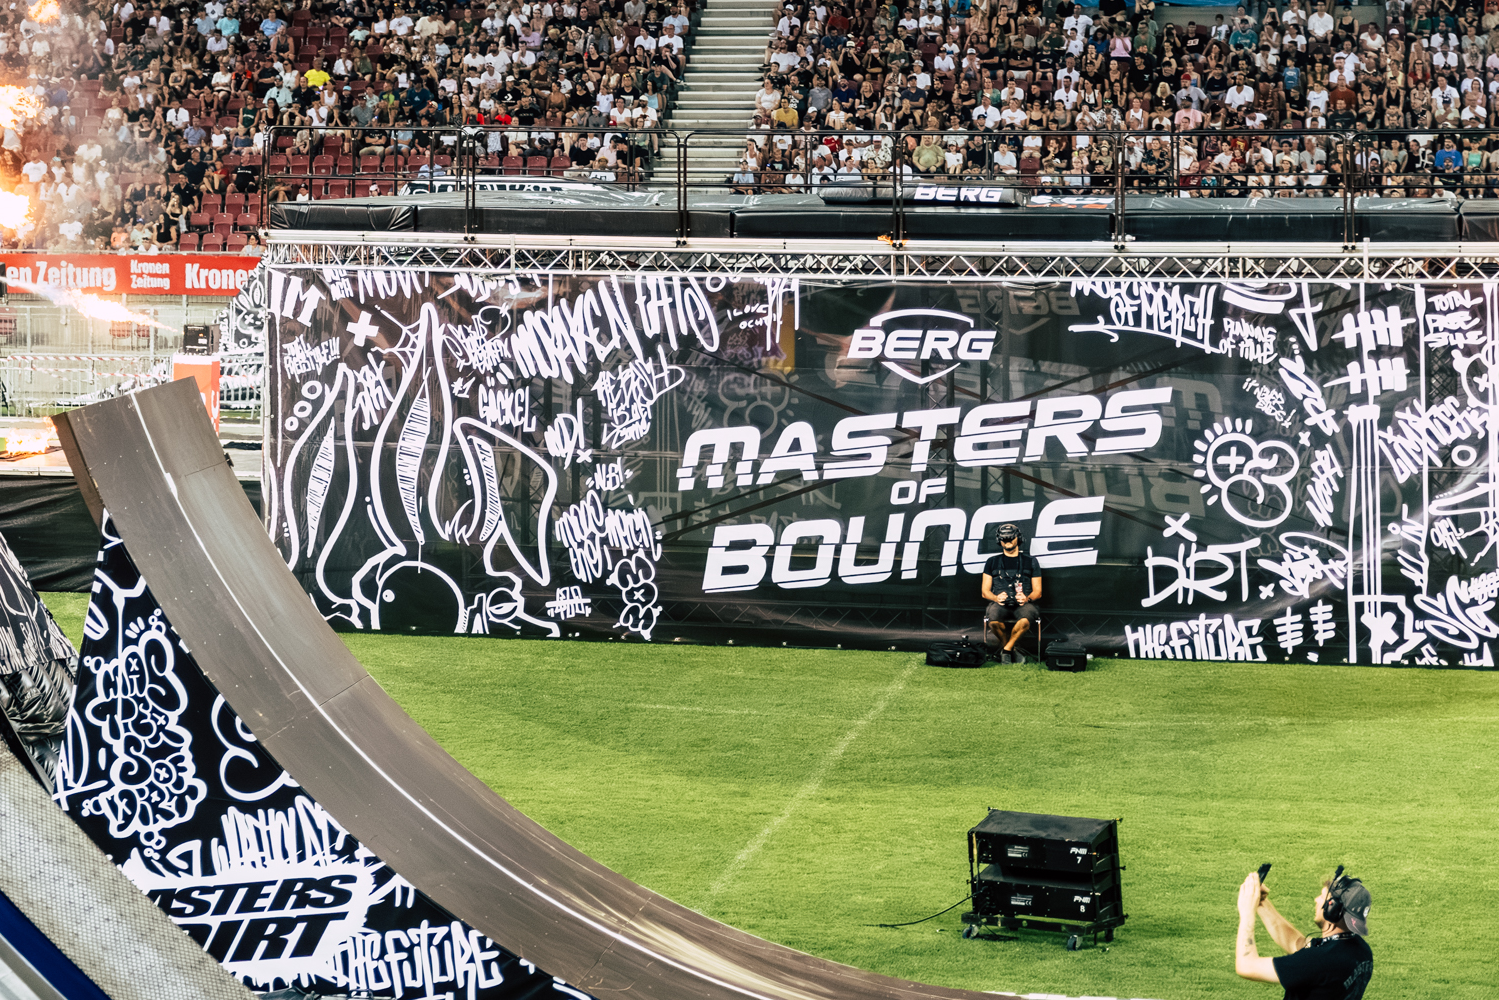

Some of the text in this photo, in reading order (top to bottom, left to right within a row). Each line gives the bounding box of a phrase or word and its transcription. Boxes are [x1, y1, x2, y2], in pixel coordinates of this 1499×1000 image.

[914, 183, 1003, 203] BERG
[35, 260, 117, 291] Zeitung
[129, 259, 170, 274] Kronen
[129, 274, 171, 290] Zeitung
[846, 330, 998, 362] BERG
[675, 387, 1174, 492] MASTERS
[889, 477, 948, 506] OF
[701, 496, 1106, 594] BOUNCE
[1076, 856, 1083, 864] 7
[1079, 905, 1086, 913] 8
